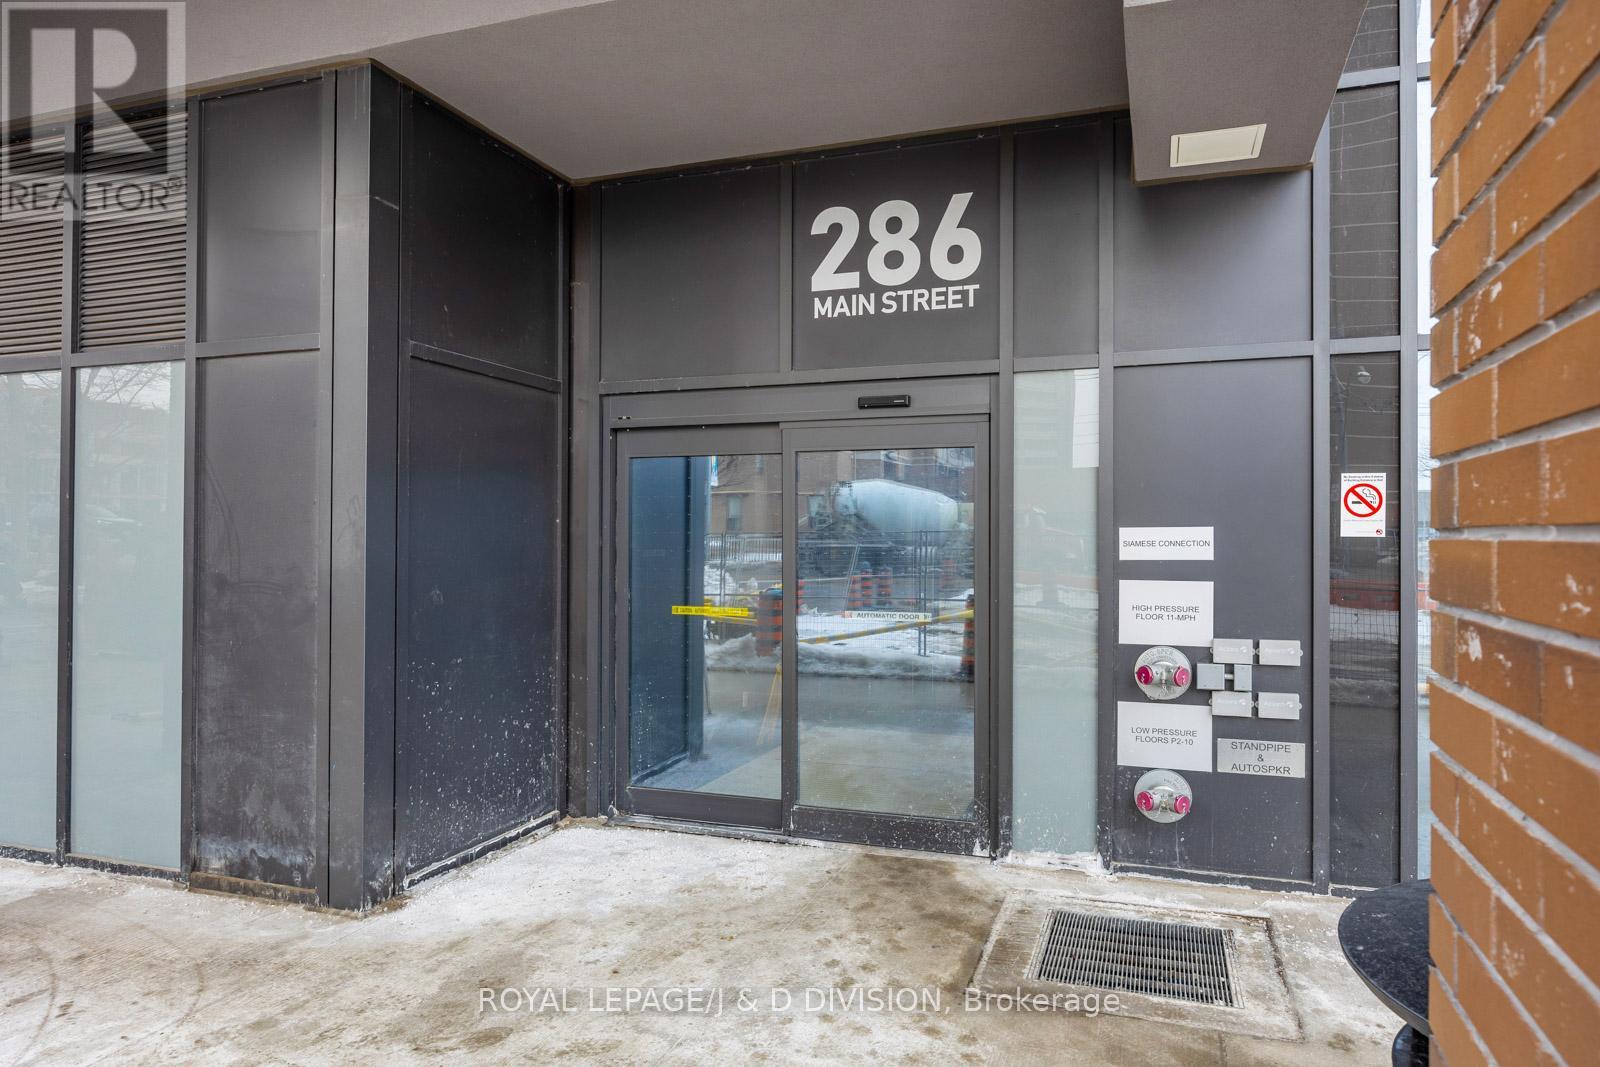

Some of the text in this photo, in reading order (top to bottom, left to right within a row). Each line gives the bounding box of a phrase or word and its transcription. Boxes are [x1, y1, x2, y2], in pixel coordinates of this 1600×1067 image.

[811, 192, 982, 292] 286
[814, 284, 980, 319] MAIN STREET
[1122, 539, 1211, 548] SIAMESE CONNECTION
[1132, 604, 1200, 614] HIGH PRESSURE
[1135, 613, 1196, 622] FLOOR 11-MPH
[1131, 726, 1198, 737] LOW PRESSURE
[1135, 735, 1194, 746] FLOORS P2-10
[1231, 742, 1291, 753] STANDPIPE
[1257, 753, 1264, 763] &
[1231, 763, 1291, 775] AUTOSPKR
